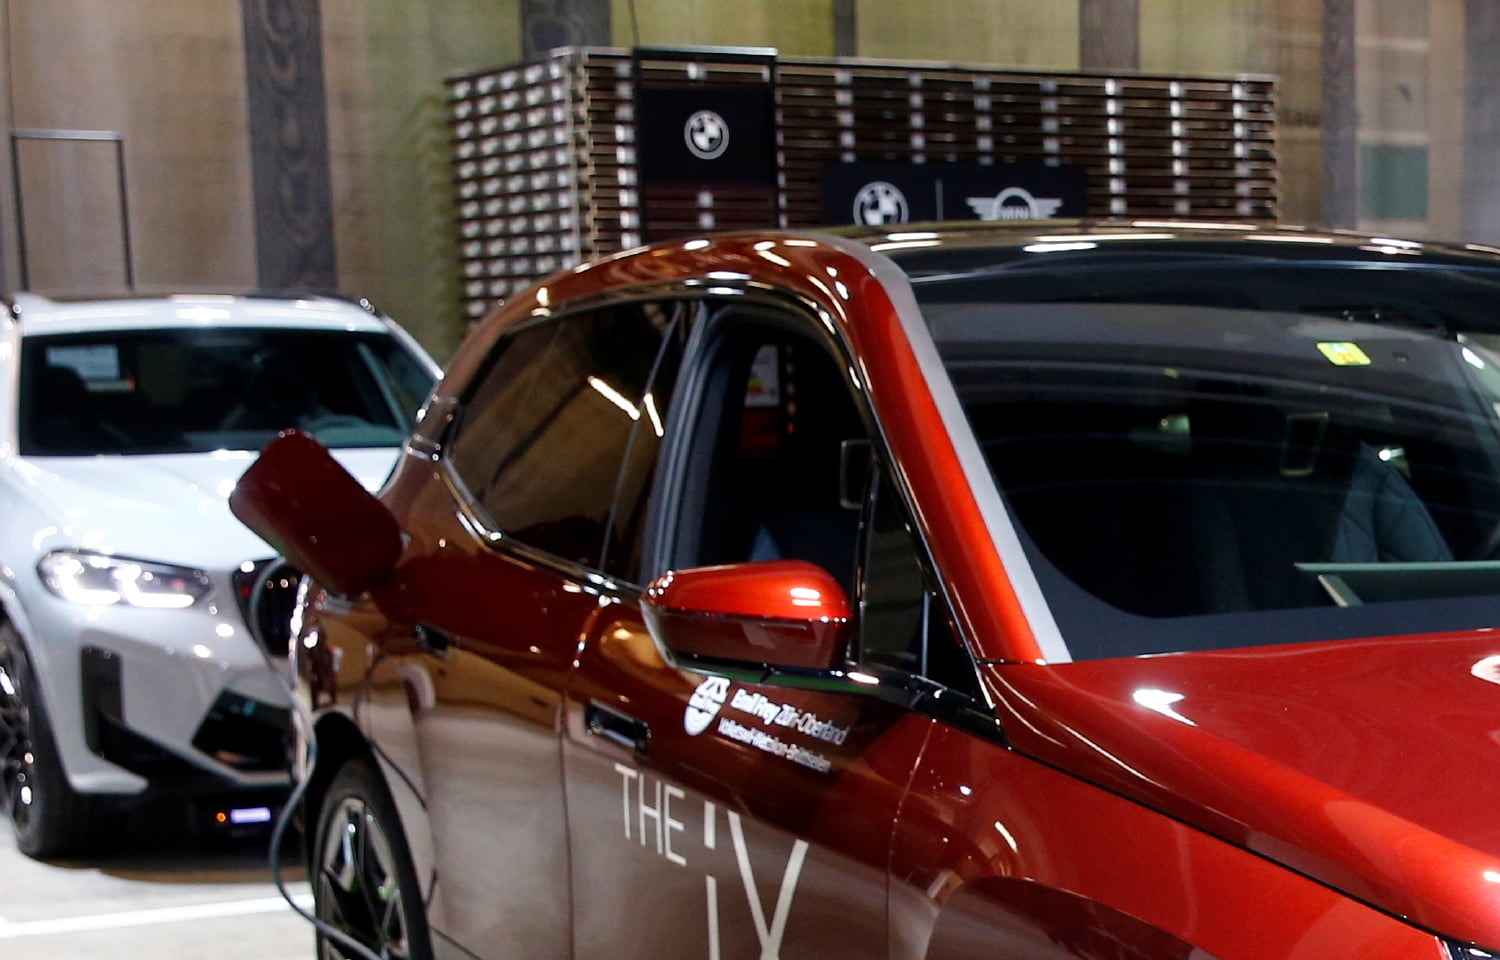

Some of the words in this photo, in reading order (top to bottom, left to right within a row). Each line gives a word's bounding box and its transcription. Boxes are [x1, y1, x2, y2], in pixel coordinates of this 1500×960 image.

[731, 688, 761, 715] Emil
[756, 695, 782, 726] Frey
[615, 762, 688, 867] THE
